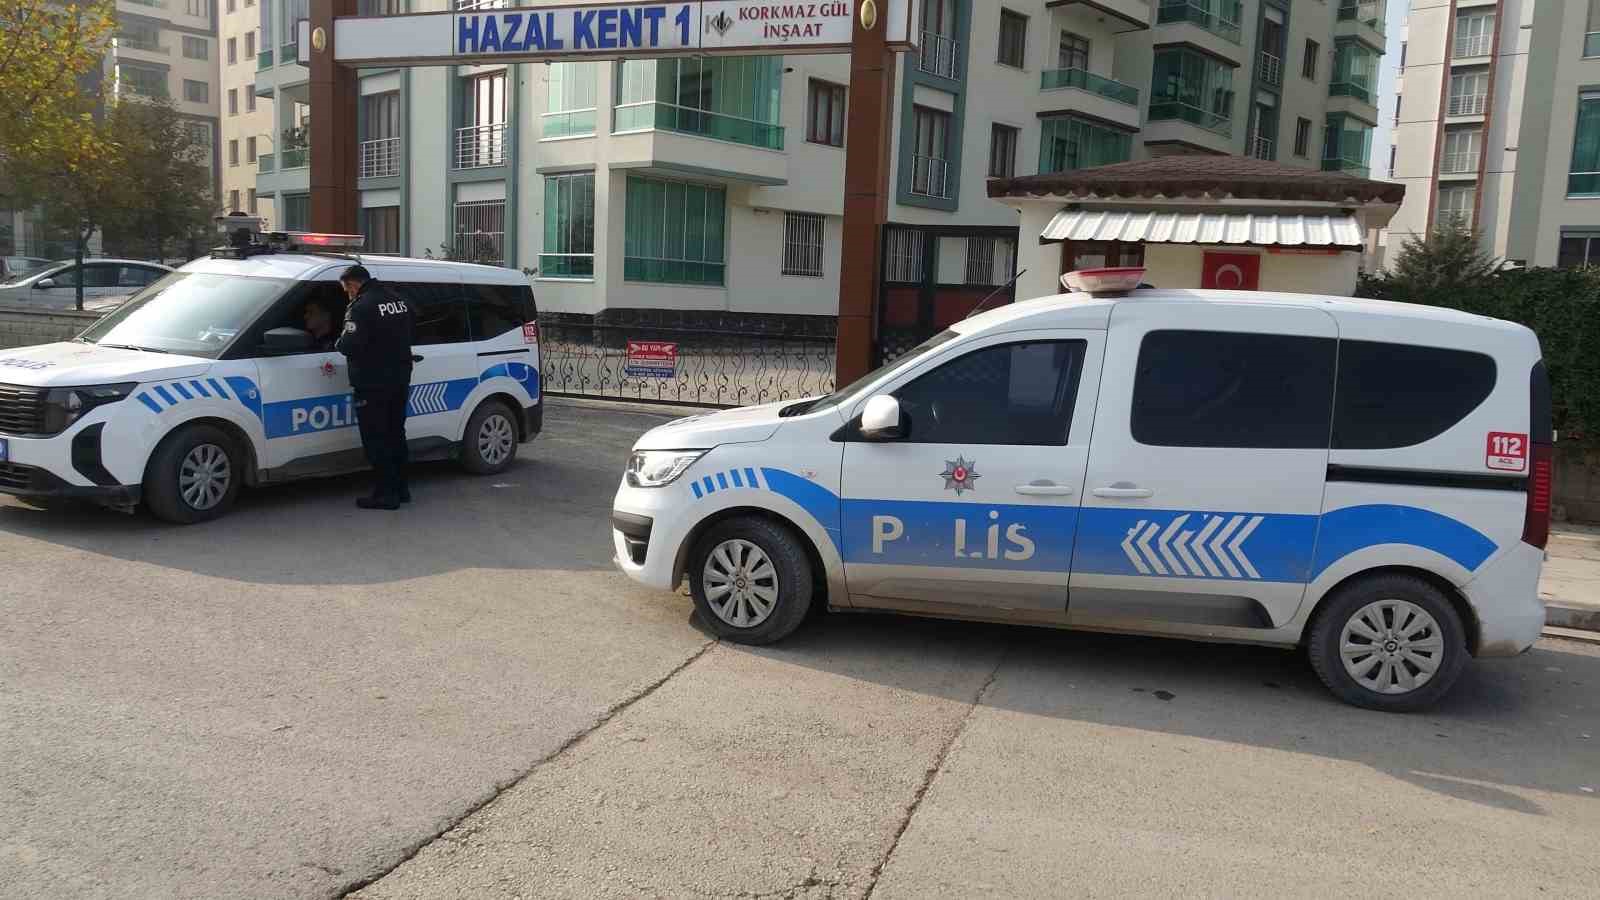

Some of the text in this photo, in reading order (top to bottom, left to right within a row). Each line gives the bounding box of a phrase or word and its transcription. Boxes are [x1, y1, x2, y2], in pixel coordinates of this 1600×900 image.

[739, 1, 850, 20] KORKMAZ GÜL
[458, 5, 690, 53] HAZAL KENT 1
[764, 22, 823, 41] İNŞAAT
[292, 395, 360, 432] POLİ
[1492, 436, 1521, 456] 112
[872, 510, 1035, 561] PLİS
